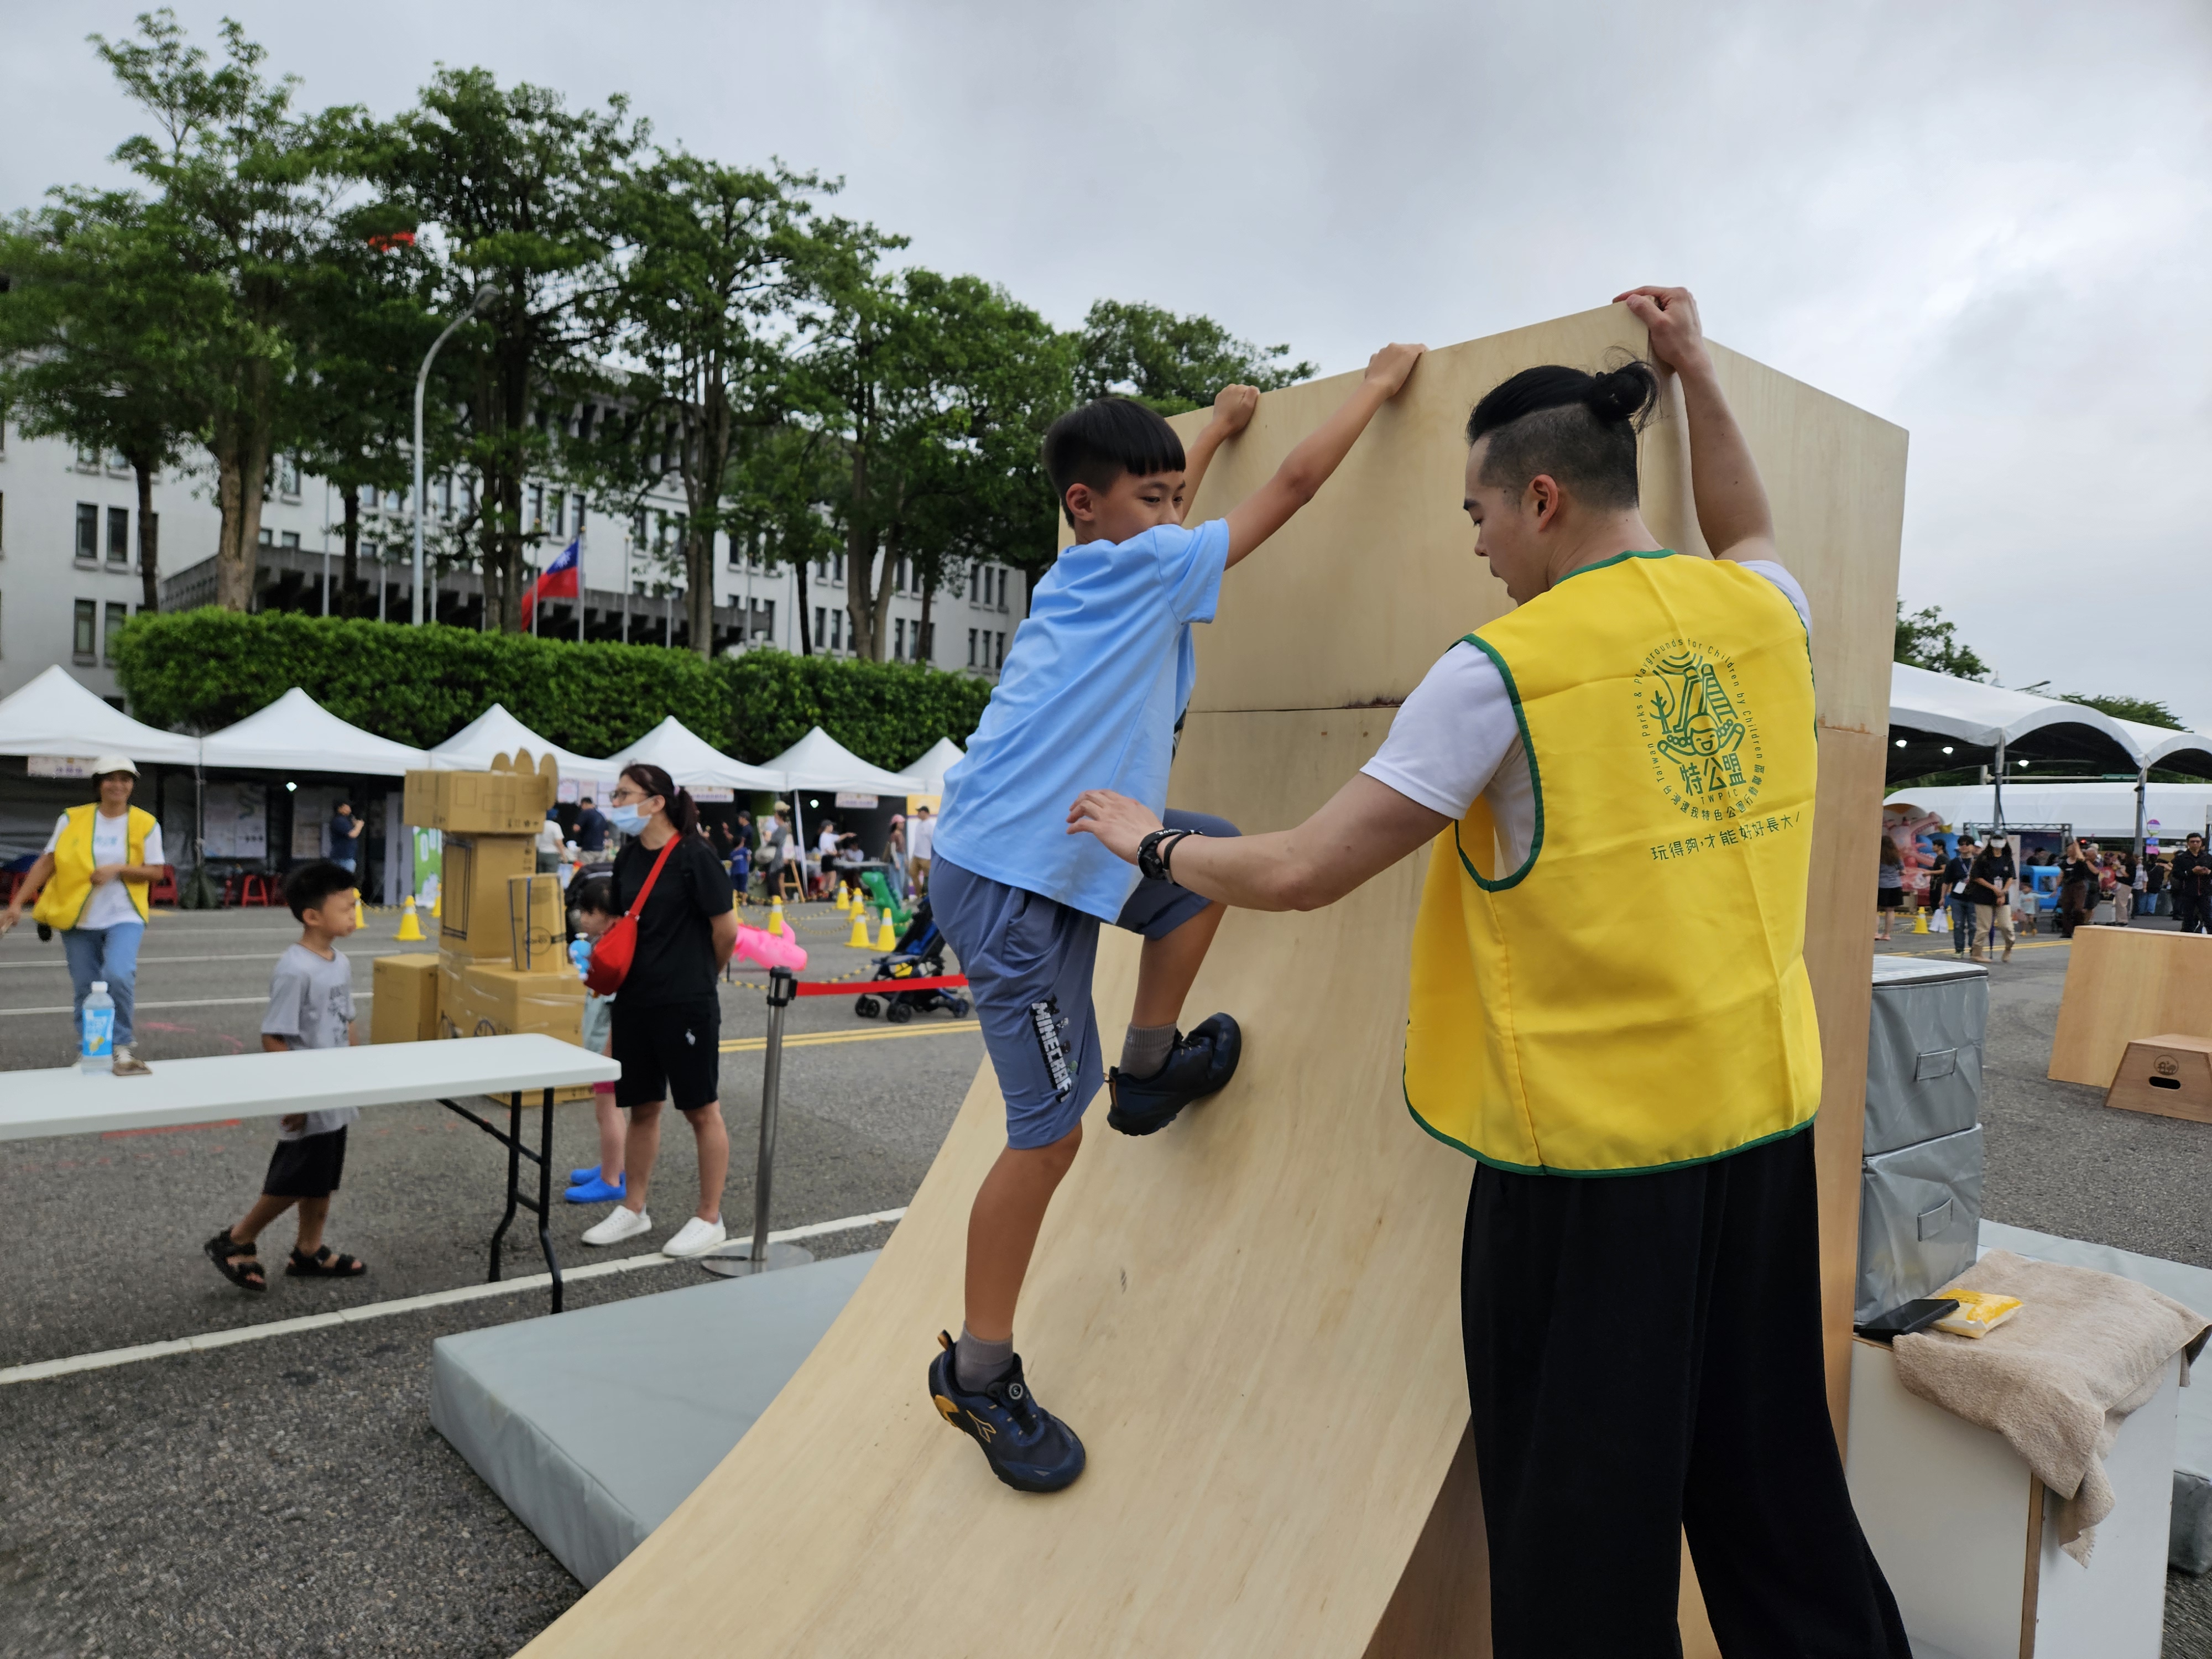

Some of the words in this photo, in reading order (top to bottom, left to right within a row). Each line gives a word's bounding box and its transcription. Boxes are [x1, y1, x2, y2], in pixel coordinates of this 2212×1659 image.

[1634, 638, 1683, 685] Playgrounds
[1687, 638, 1703, 649] for
[1707, 646, 1740, 687] Children
[1736, 692, 1746, 704] by
[1636, 704, 1651, 737] Parks
[1743, 710, 1763, 759] Children
[1647, 743, 1665, 783] Taiwan
[1679, 752, 1747, 796] 特公盟
[1700, 789, 1738, 805] TWPIC
